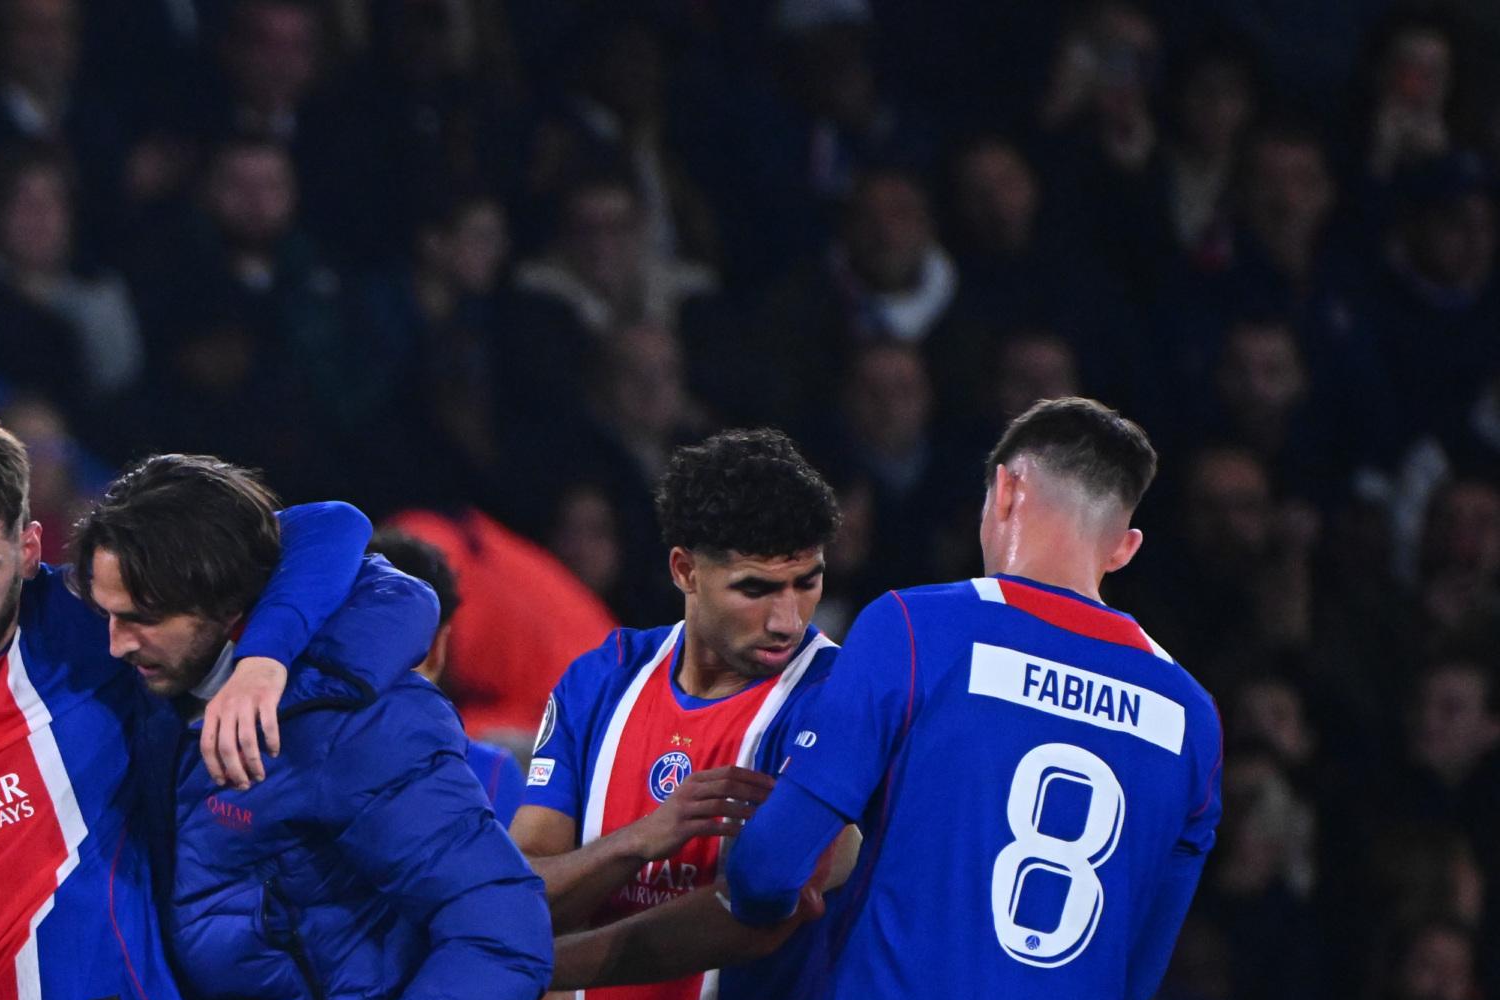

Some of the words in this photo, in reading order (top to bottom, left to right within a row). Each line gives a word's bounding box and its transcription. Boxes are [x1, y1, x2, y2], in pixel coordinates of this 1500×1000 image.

[1022, 663, 1141, 727] FABIAN
[663, 755, 689, 769] PARIS
[991, 743, 1125, 968] 8
